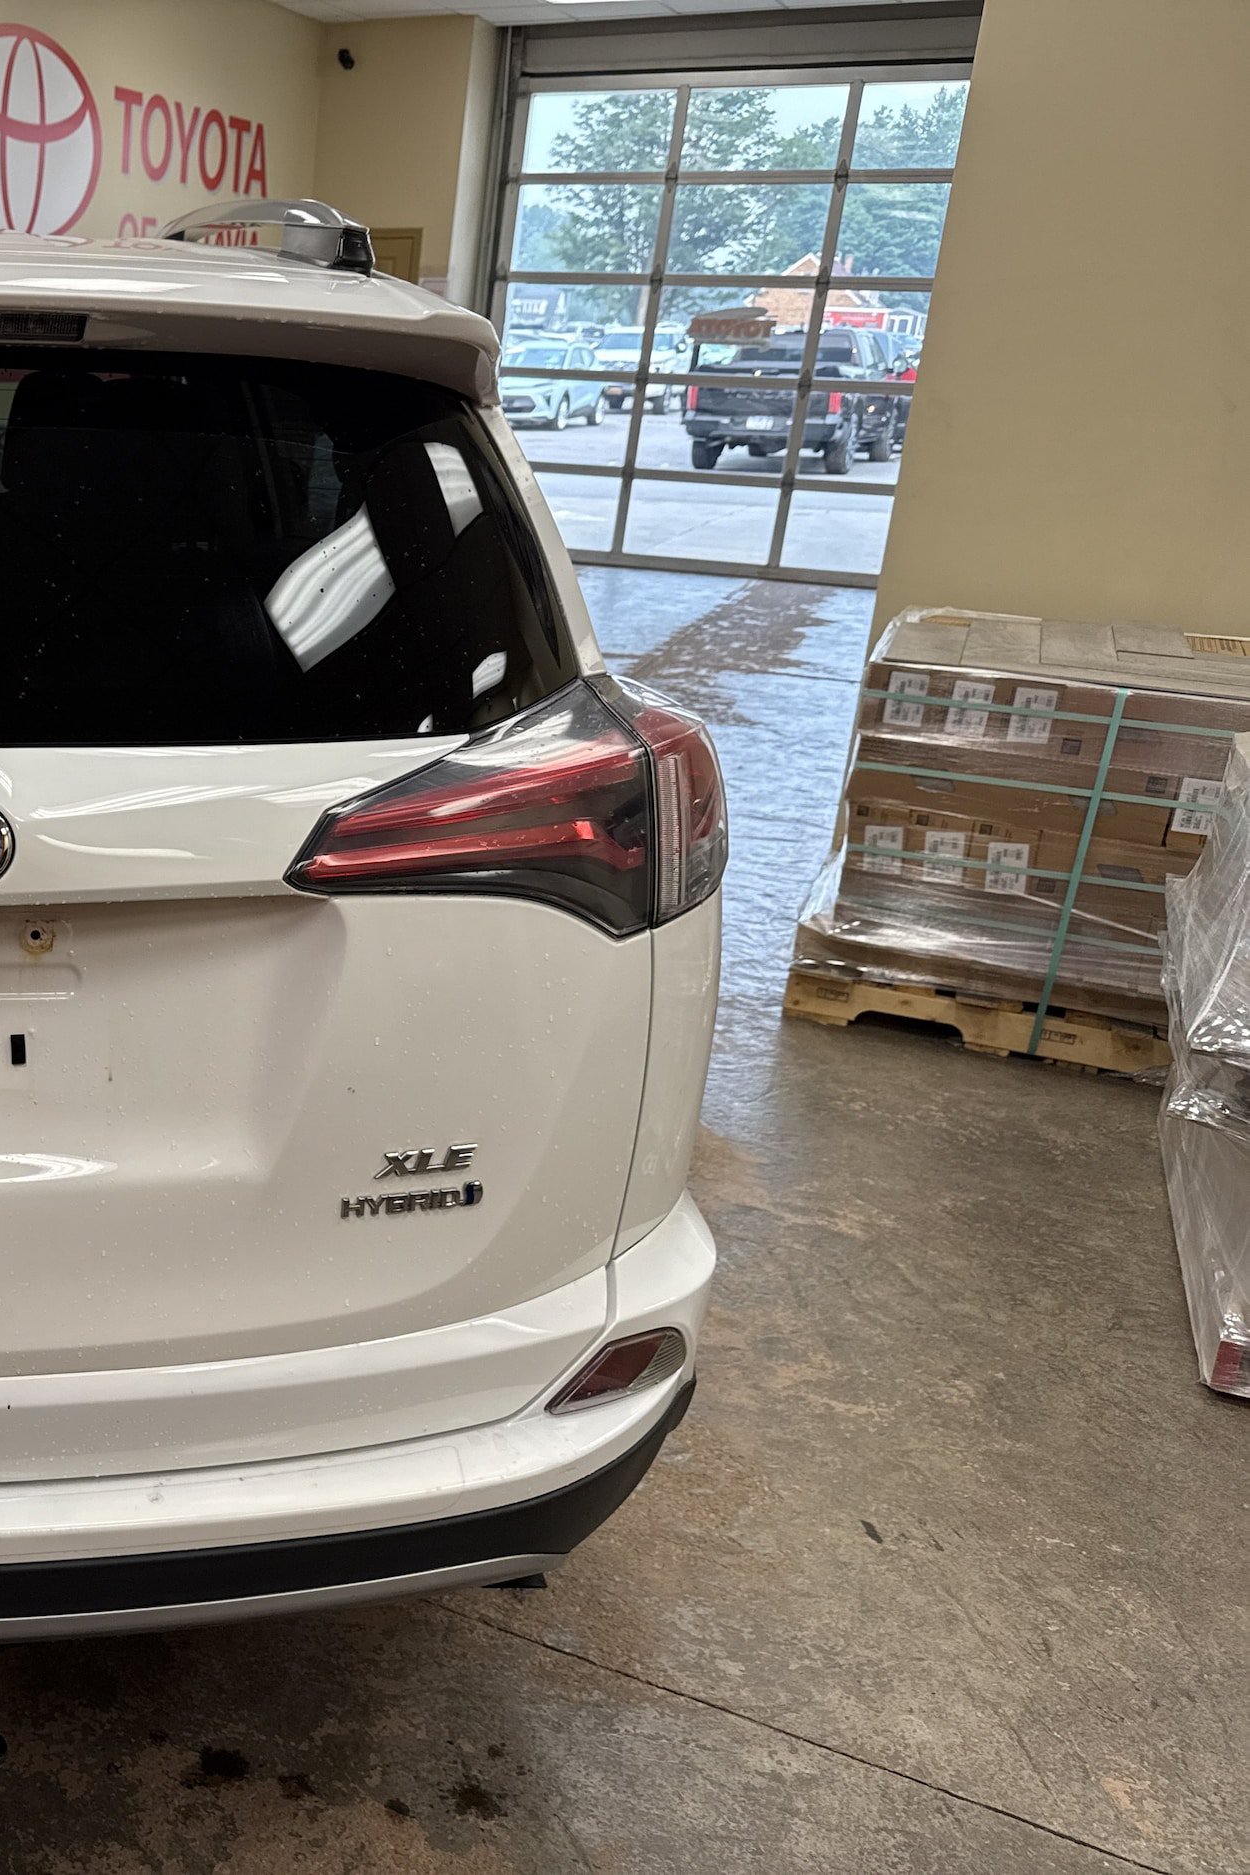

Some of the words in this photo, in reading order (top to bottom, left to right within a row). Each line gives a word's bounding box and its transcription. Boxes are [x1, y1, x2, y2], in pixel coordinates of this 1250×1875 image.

[114, 86, 267, 198] TOYOTA
[374, 1143, 478, 1179] XLE
[341, 1186, 462, 1218] HYBRID
